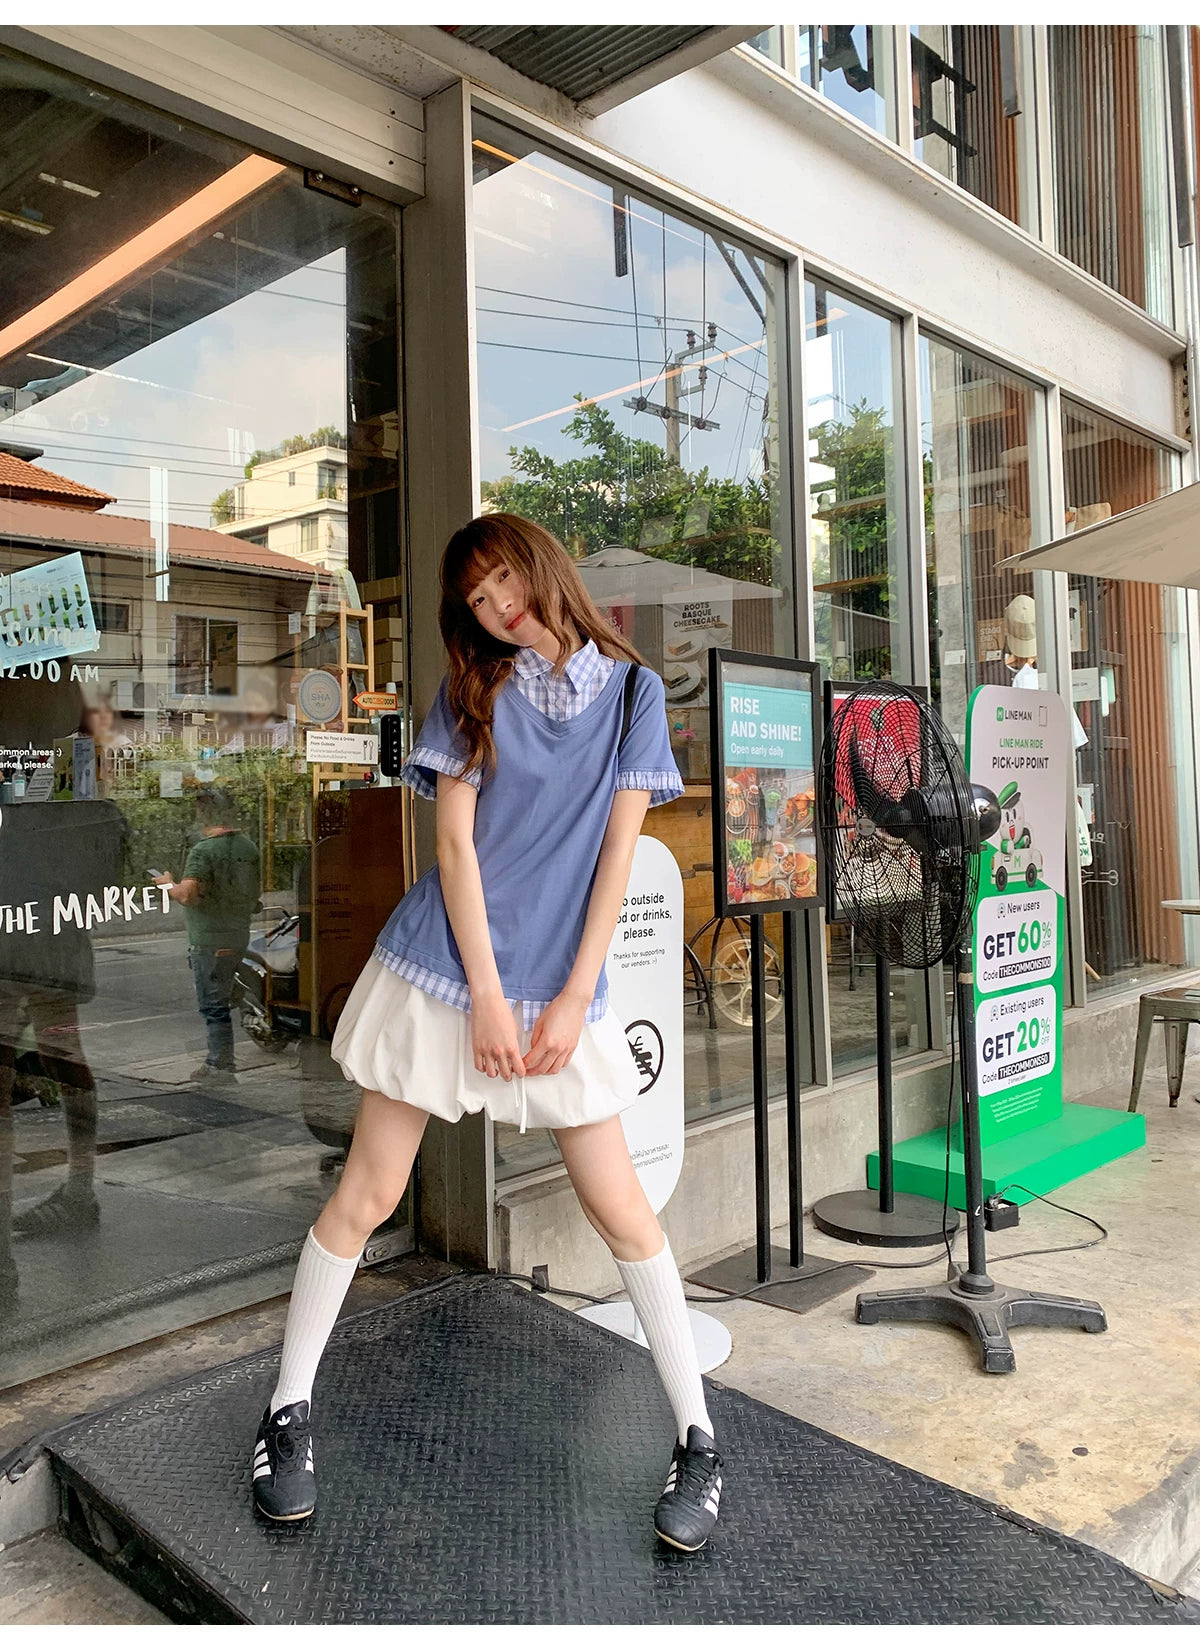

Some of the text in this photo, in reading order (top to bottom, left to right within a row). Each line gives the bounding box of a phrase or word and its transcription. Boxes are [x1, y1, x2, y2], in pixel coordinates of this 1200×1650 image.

[684, 602, 710, 611] ROOTS
[682, 610, 712, 619] BASQUE
[673, 615, 721, 628] CHEESECAKE
[70, 664, 100, 683] AM
[730, 696, 760, 715] RISE
[730, 720, 802, 741] AND SHINE!
[1000, 738, 1043, 749] LINE MAN RIDE
[730, 743, 784, 758] Open early daily
[24, 761, 54, 769] please.
[992, 757, 1048, 769] PICK-UP POINT
[622, 893, 664, 906] o outside
[0, 883, 173, 935] THE MARKET
[1007, 901, 1040, 914] New users
[630, 913, 640, 922] or
[643, 908, 672, 921] drinks,
[624, 928, 656, 941] please.
[984, 931, 1016, 960] GET
[640, 948, 665, 957] supporting
[983, 970, 998, 981] Code
[1000, 997, 1044, 1016] Existing users
[982, 1031, 1014, 1063] GET
[982, 1073, 997, 1085] Code
